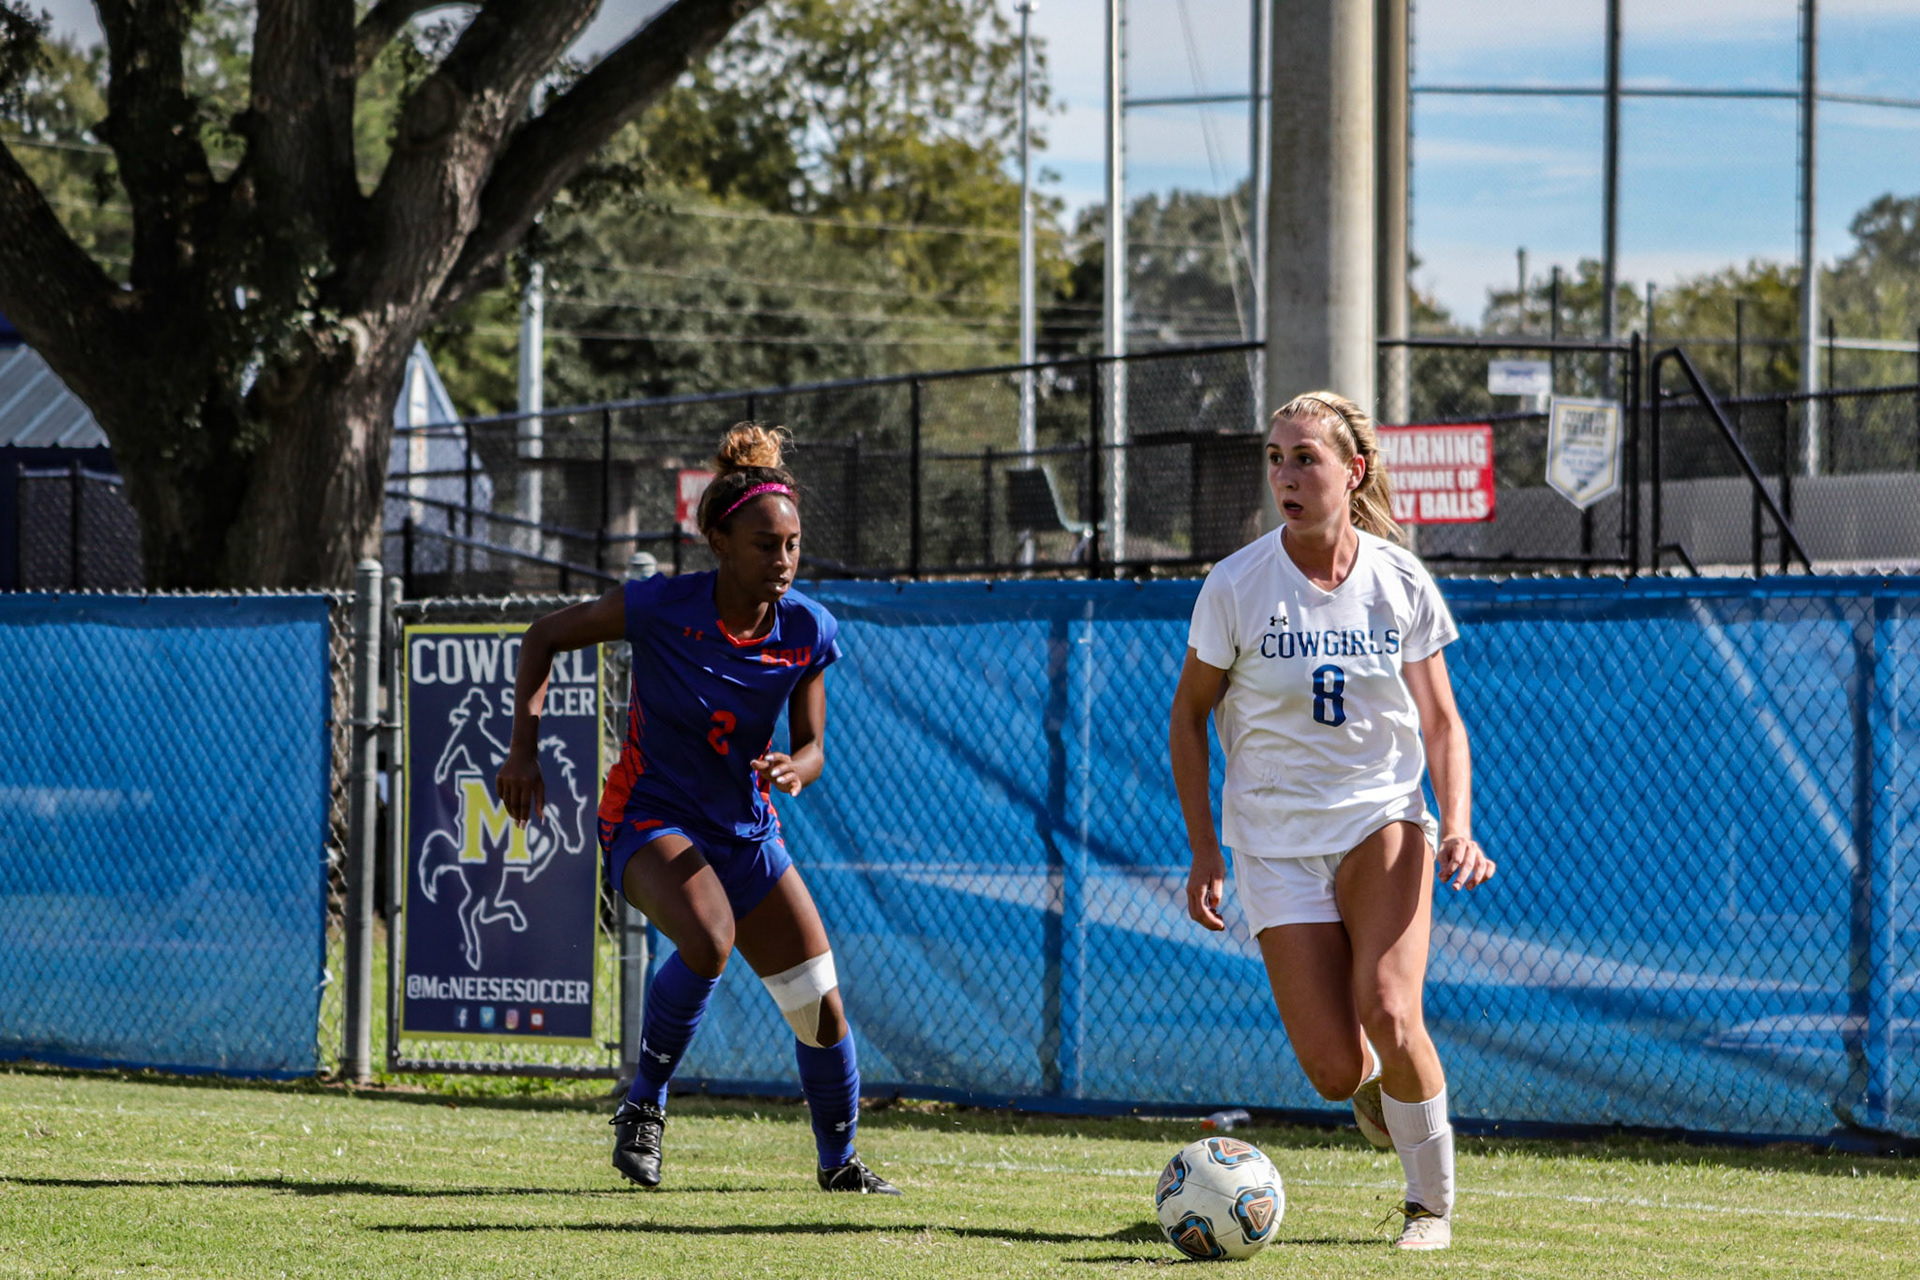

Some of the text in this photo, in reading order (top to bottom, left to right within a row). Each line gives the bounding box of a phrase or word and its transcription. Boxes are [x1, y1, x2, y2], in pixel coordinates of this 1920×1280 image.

[1378, 433, 1487, 465] WARNING
[1458, 469, 1478, 490] OF
[1392, 490, 1488, 519] LY BALLS
[1260, 629, 1400, 659] COWGIRLS
[411, 638, 596, 685] COWGRL
[1312, 663, 1347, 728] 8
[707, 709, 737, 756] 2
[406, 974, 590, 1005] @McNEESESOCCER
